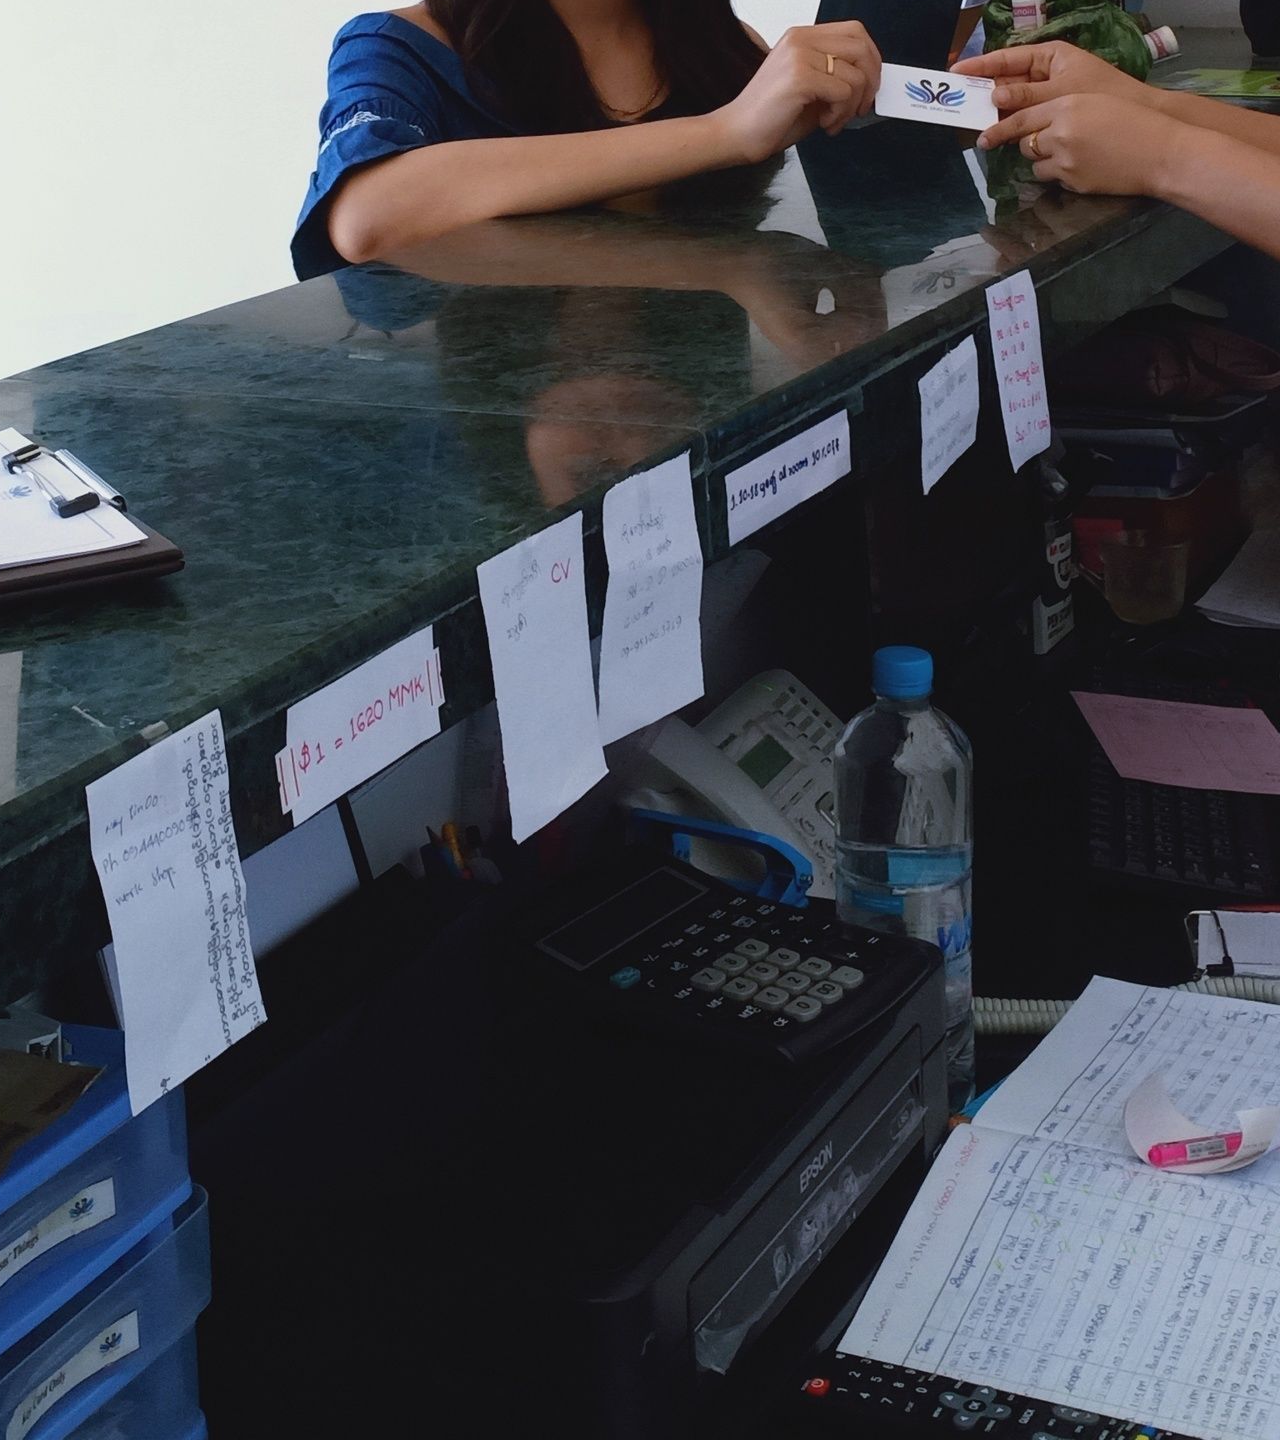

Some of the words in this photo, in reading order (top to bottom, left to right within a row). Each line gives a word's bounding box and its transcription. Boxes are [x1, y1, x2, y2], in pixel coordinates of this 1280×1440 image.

[551, 558, 571, 583] CV
[349, 699, 384, 742] 1620
[388, 673, 425, 712] MMK
[800, 1140, 832, 1194] EPSON
